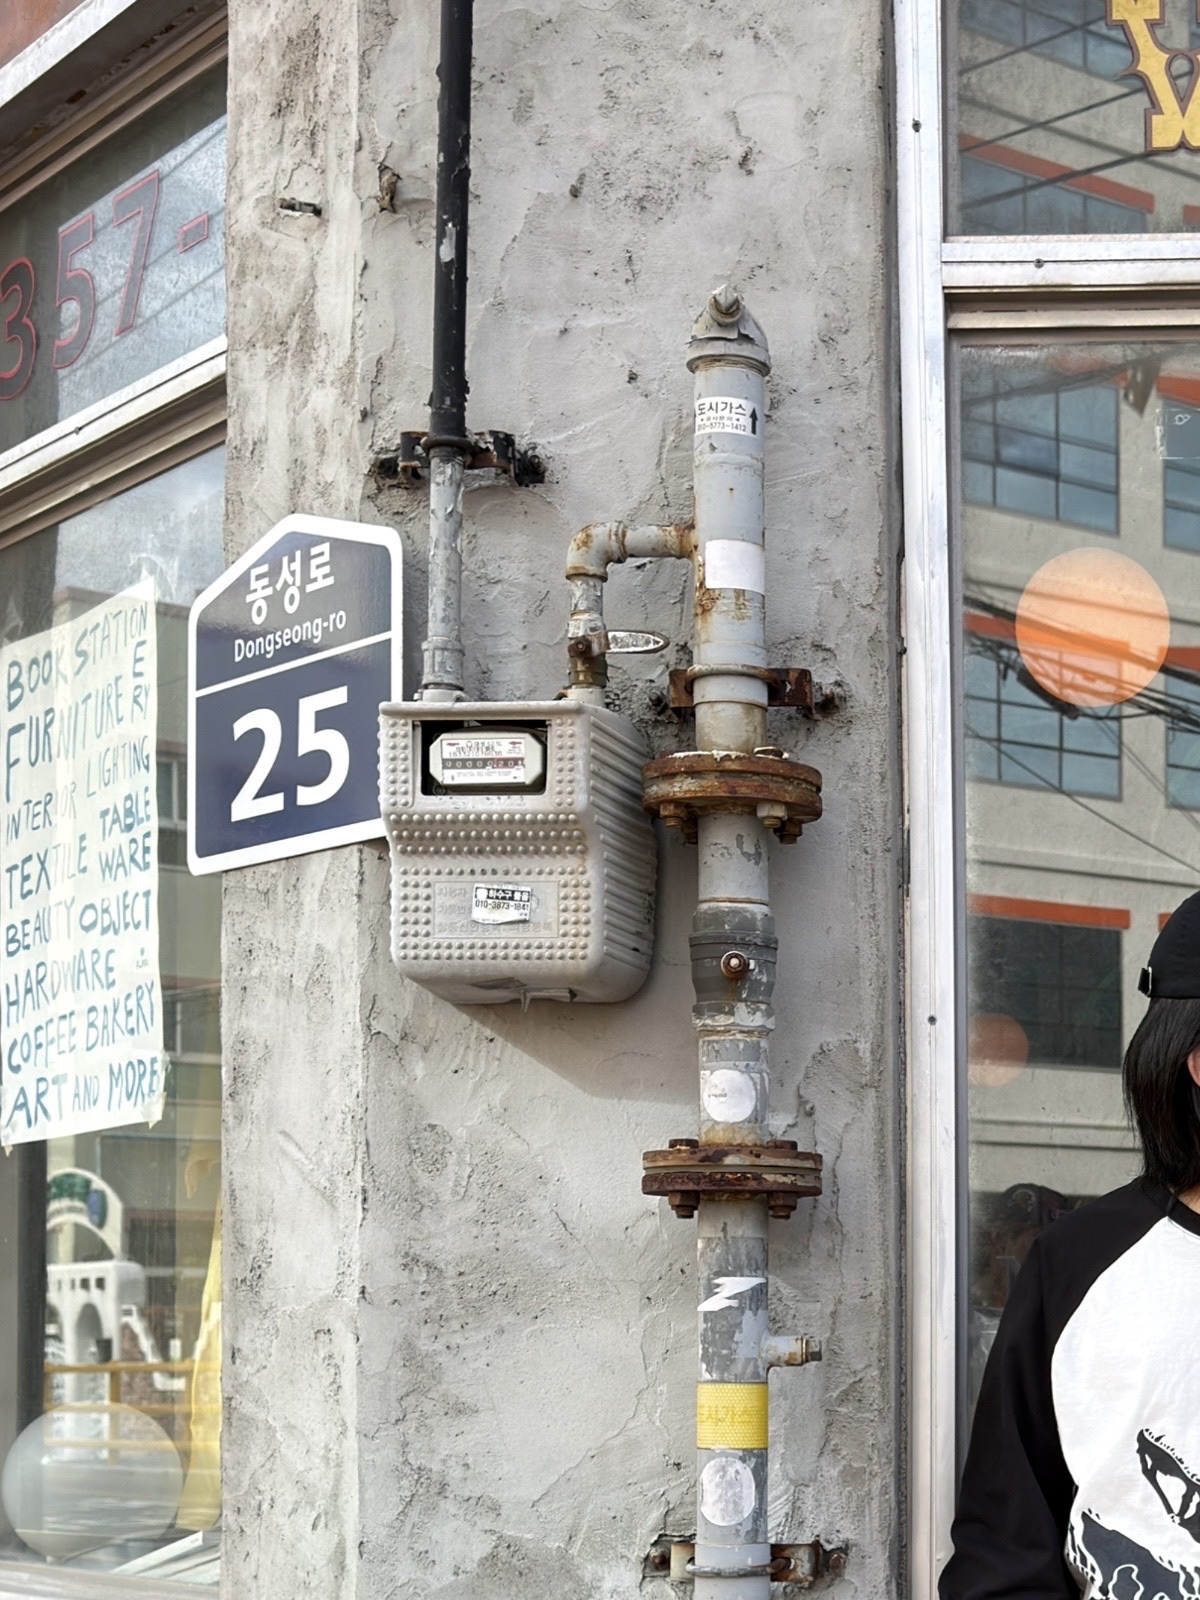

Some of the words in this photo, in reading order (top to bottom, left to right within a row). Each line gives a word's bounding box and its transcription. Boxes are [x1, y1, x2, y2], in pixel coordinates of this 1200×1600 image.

[0, 170, 208, 400] 357-
[698, 401, 747, 417] 도시가스
[245, 541, 335, 625] 동성로
[7, 645, 69, 712] BOOK
[74, 601, 149, 677] STATION
[132, 640, 148, 679] E
[234, 609, 347, 663] Dongseong-ro
[6, 674, 125, 804] FURNITURE
[131, 683, 151, 724] RY
[7, 781, 77, 847] INTERIOR
[86, 735, 151, 798] LIGHTING
[230, 685, 351, 823] 25
[100, 785, 151, 842] TABLE
[5, 832, 88, 910] TEXTILE
[99, 830, 152, 882] WARE
[475, 900, 529, 911] 010-3873-1841
[6, 895, 76, 958] BEAUTY
[79, 888, 152, 936] OBJECT
[6, 948, 116, 1028] HARDWARE
[7, 1010, 76, 1075] COFFEE
[86, 980, 155, 1052] BAKERY
[6, 1072, 69, 1129] ART
[72, 1074, 99, 1112] AND
[108, 1056, 159, 1112] MORE
